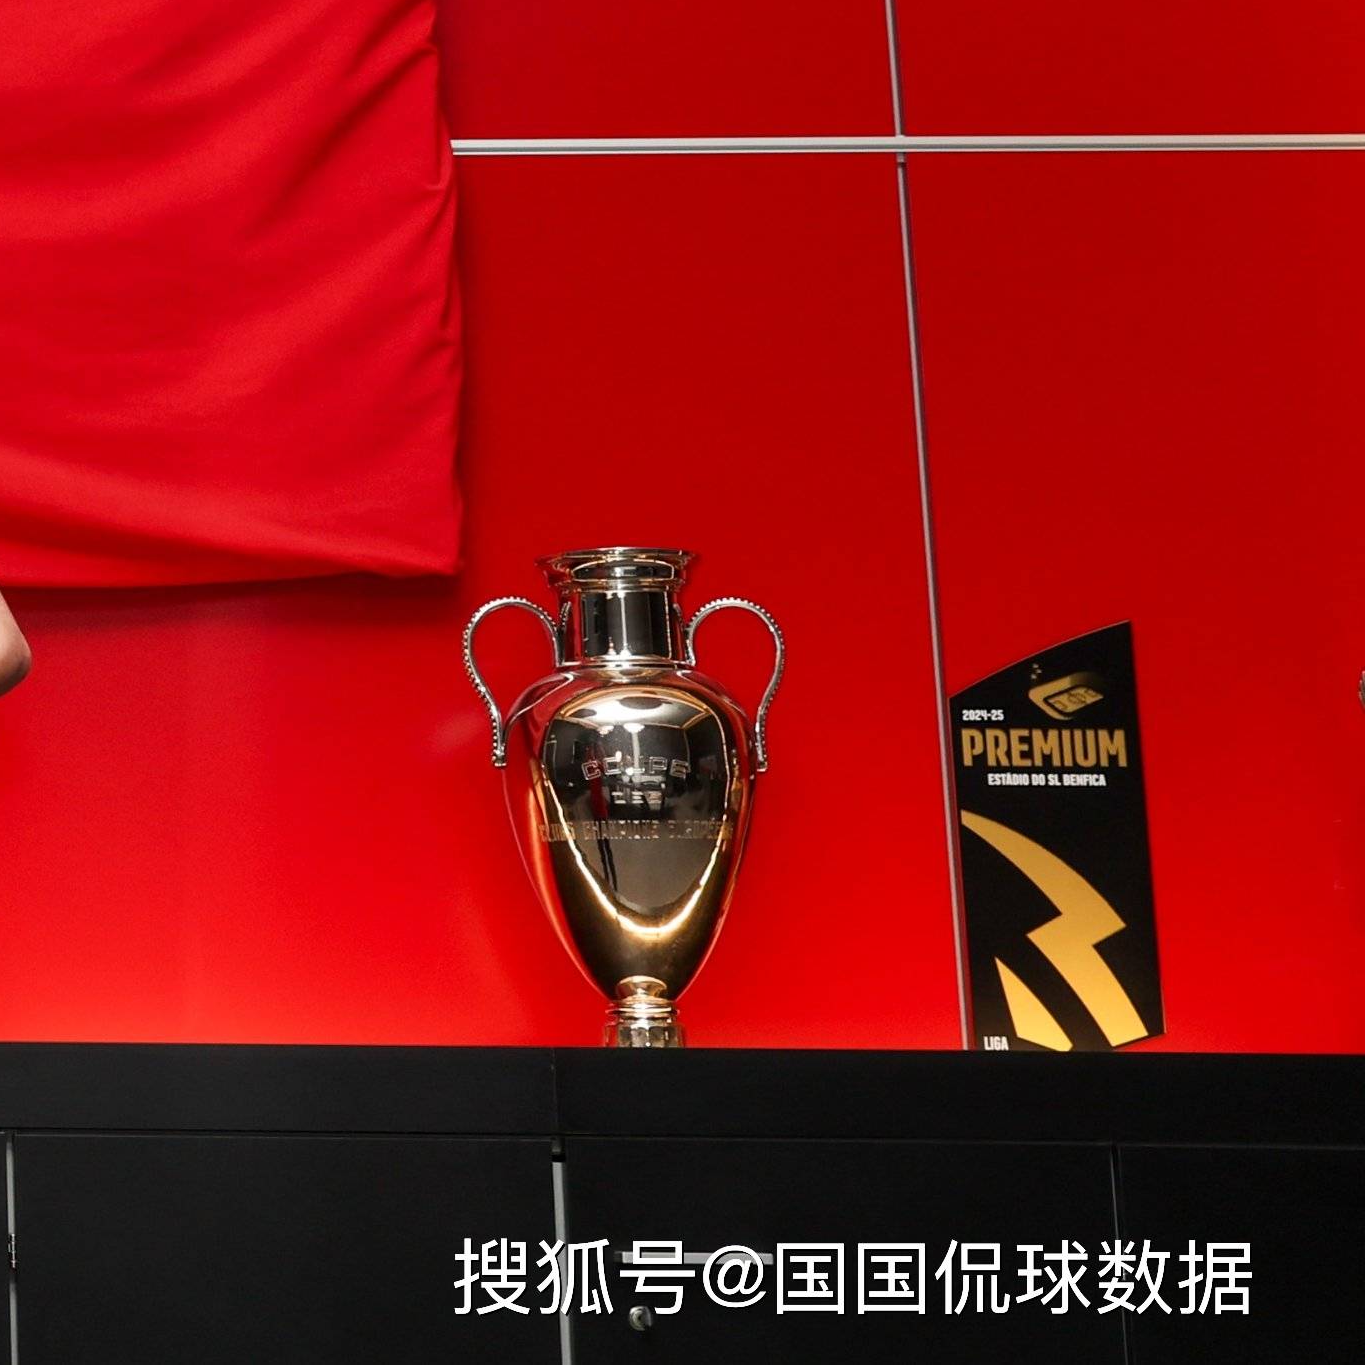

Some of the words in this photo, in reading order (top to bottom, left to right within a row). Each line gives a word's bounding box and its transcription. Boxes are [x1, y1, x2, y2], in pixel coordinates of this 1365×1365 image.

[961, 709, 1005, 722] 2024-25
[961, 728, 1128, 768] PREMIUM
[987, 772, 1030, 786] ESTÁDIO
[1031, 773, 1046, 786] DO
[1047, 773, 1062, 786] SL
[1062, 773, 1107, 787] BENFICA
[983, 1035, 1009, 1051] LIGA
